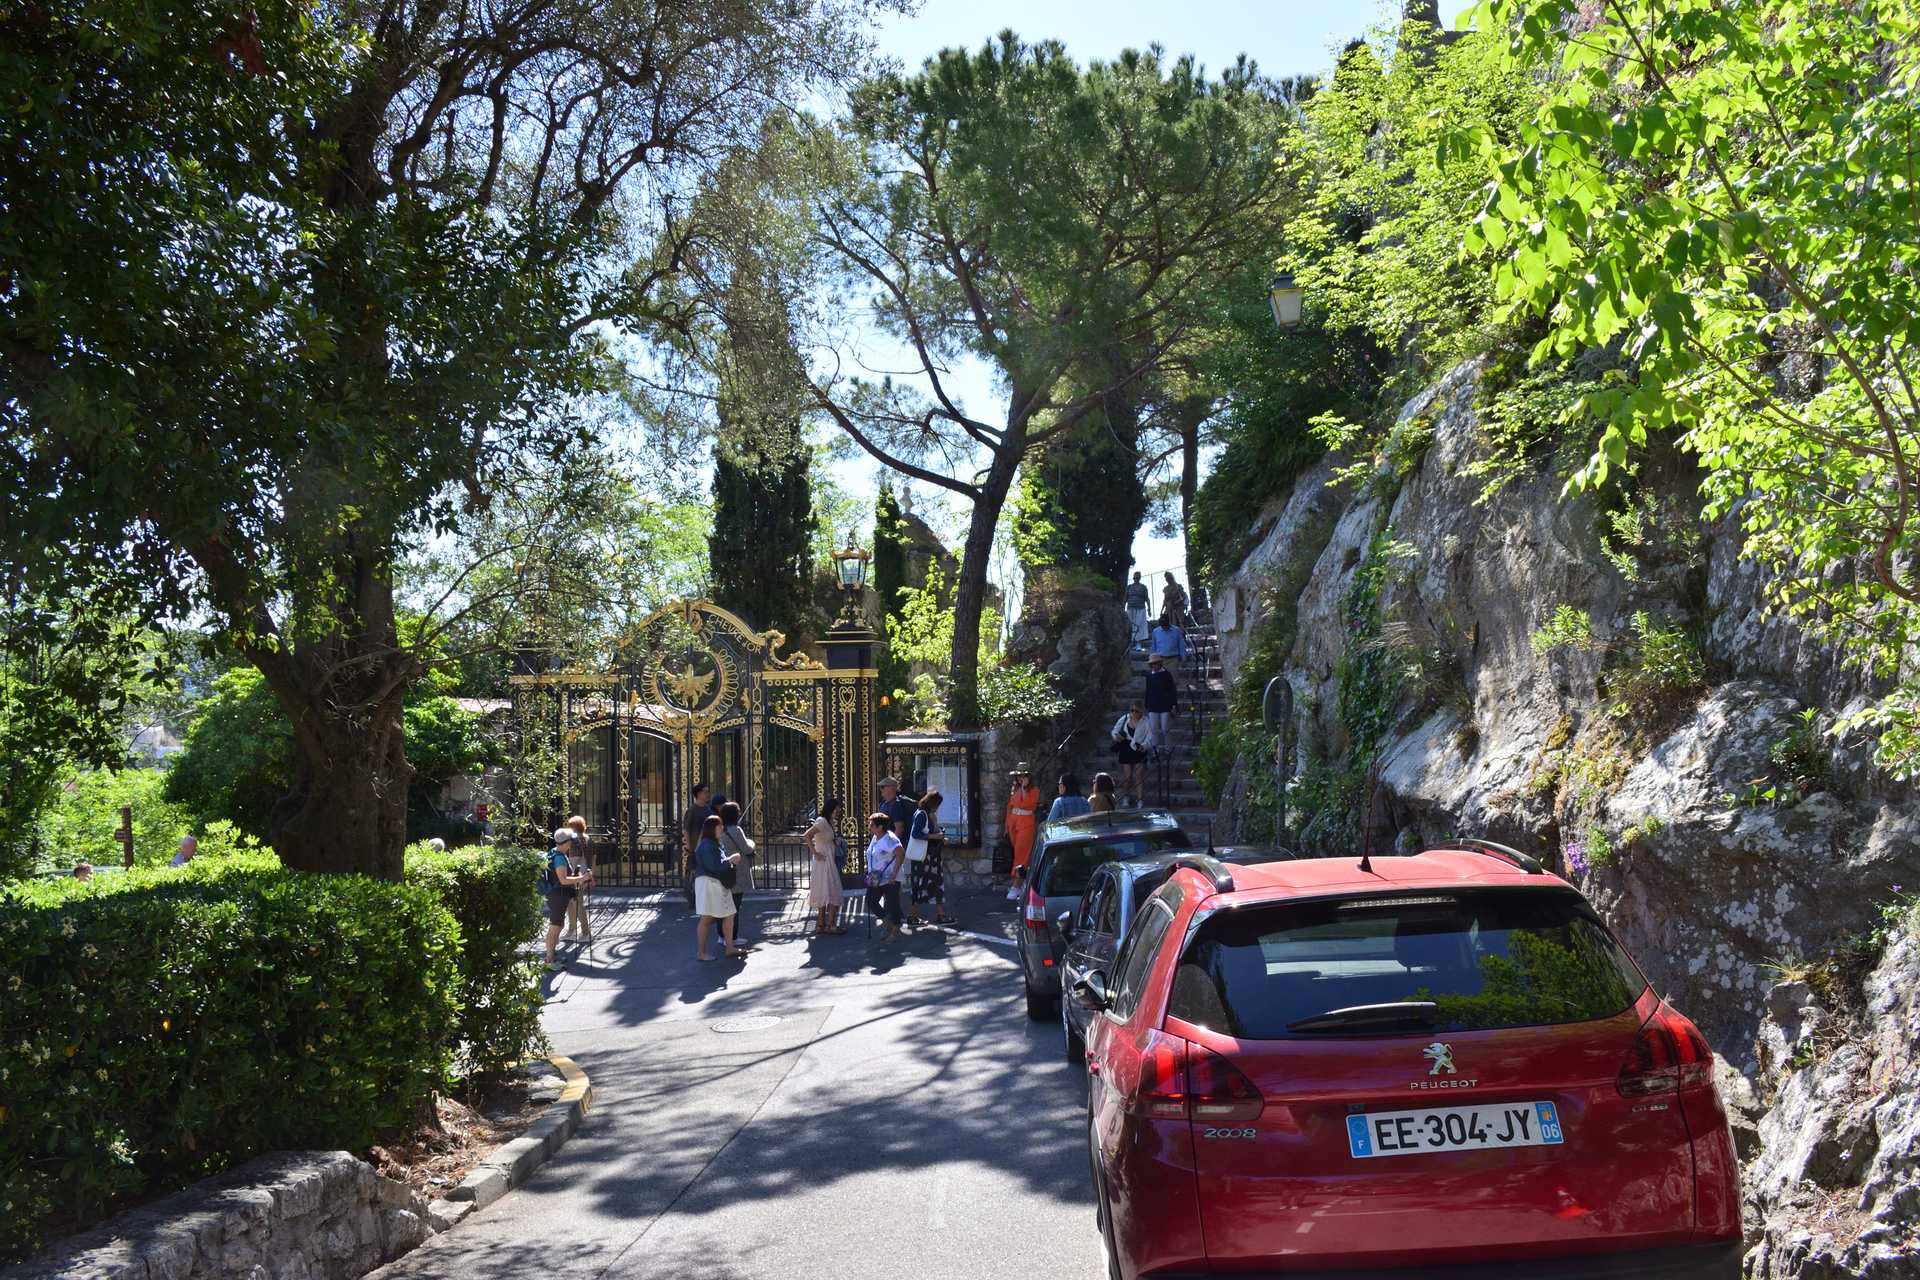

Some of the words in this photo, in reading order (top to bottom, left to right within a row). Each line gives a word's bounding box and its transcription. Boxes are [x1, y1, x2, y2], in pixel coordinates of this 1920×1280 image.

[1409, 1079, 1478, 1090] PEUGEOT
[1204, 1127, 1256, 1138] 2008
[1374, 1109, 1530, 1151] EE-304-JY
[1542, 1123, 1560, 1139] 06
[1358, 1140, 1365, 1149] F
